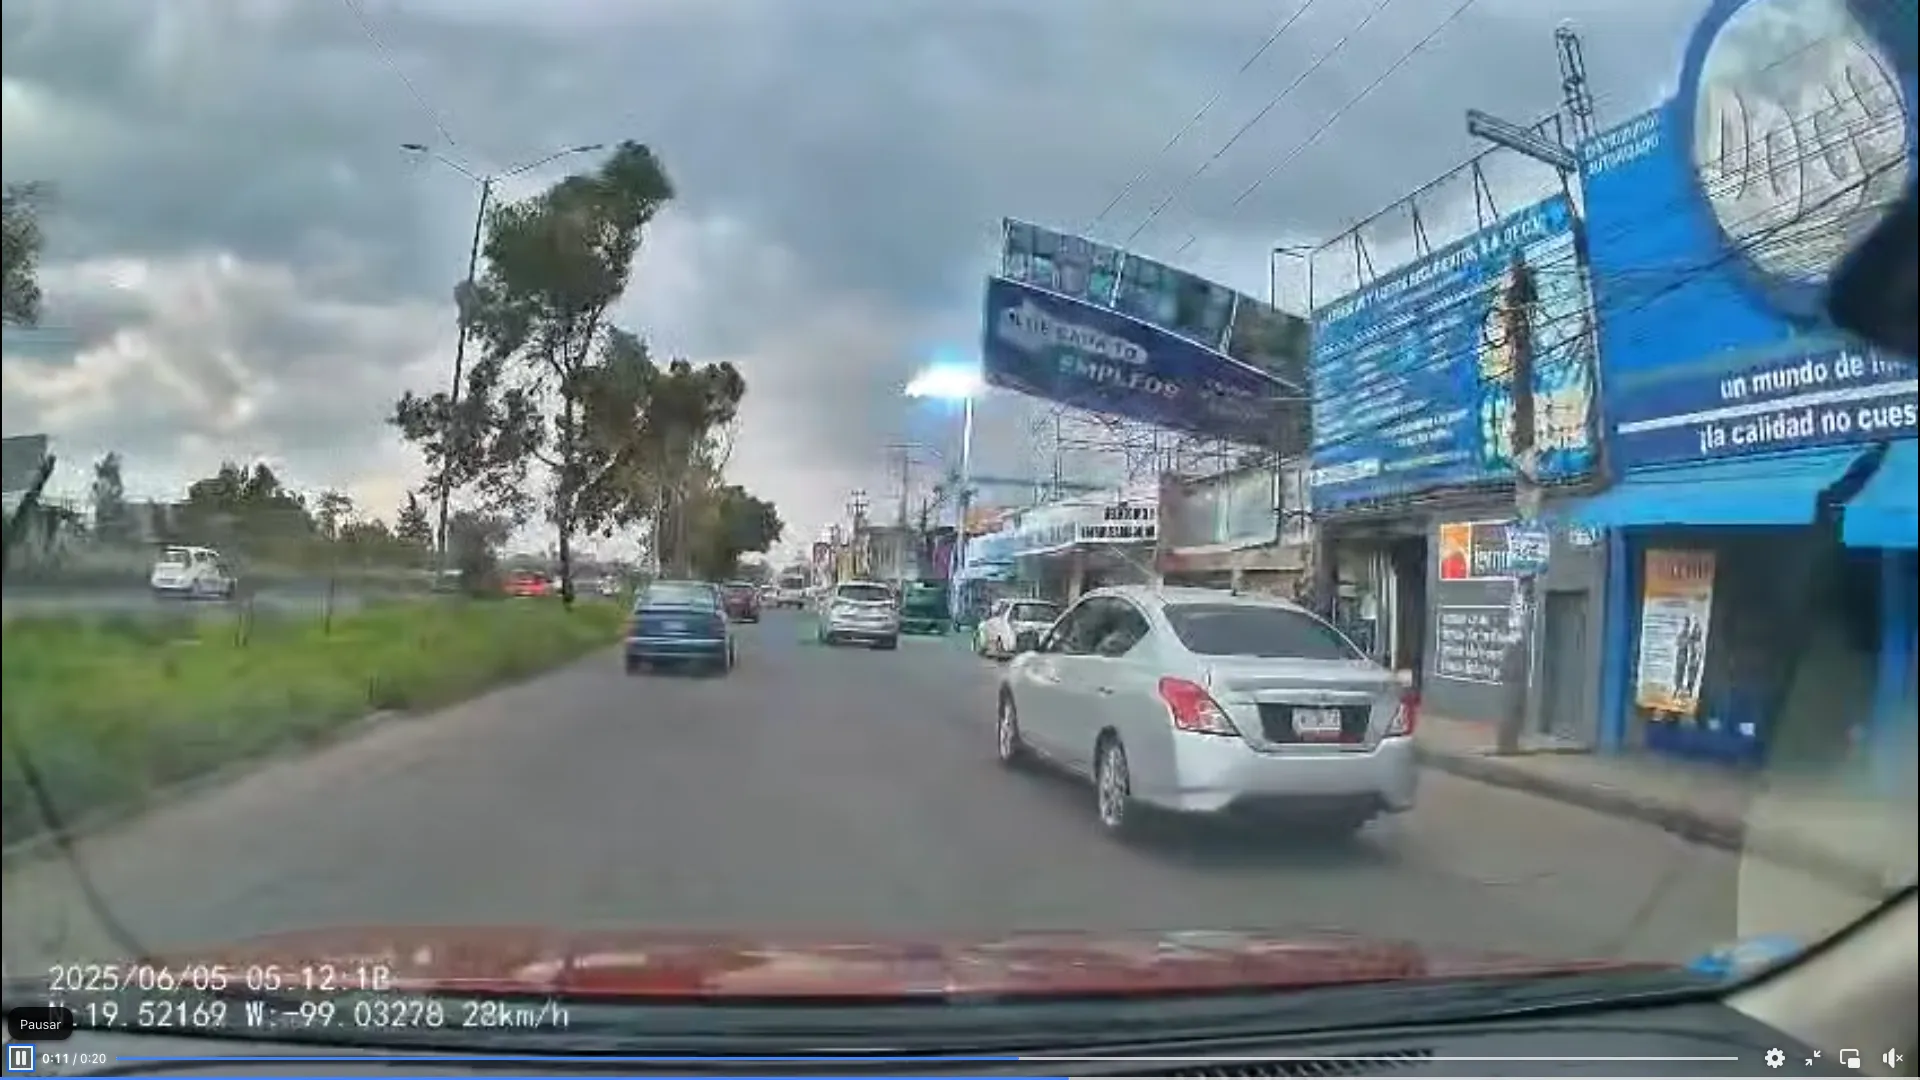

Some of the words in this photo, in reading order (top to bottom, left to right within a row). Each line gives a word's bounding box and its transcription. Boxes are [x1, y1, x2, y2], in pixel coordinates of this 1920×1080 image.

[1058, 352, 1181, 399] EMPLEOS
[1720, 376, 1747, 400] un
[1752, 358, 1828, 394] mundo
[1835, 351, 1864, 379] de
[1731, 408, 1814, 446] calidad
[1821, 412, 1851, 435] no
[1858, 403, 1917, 431] cues
